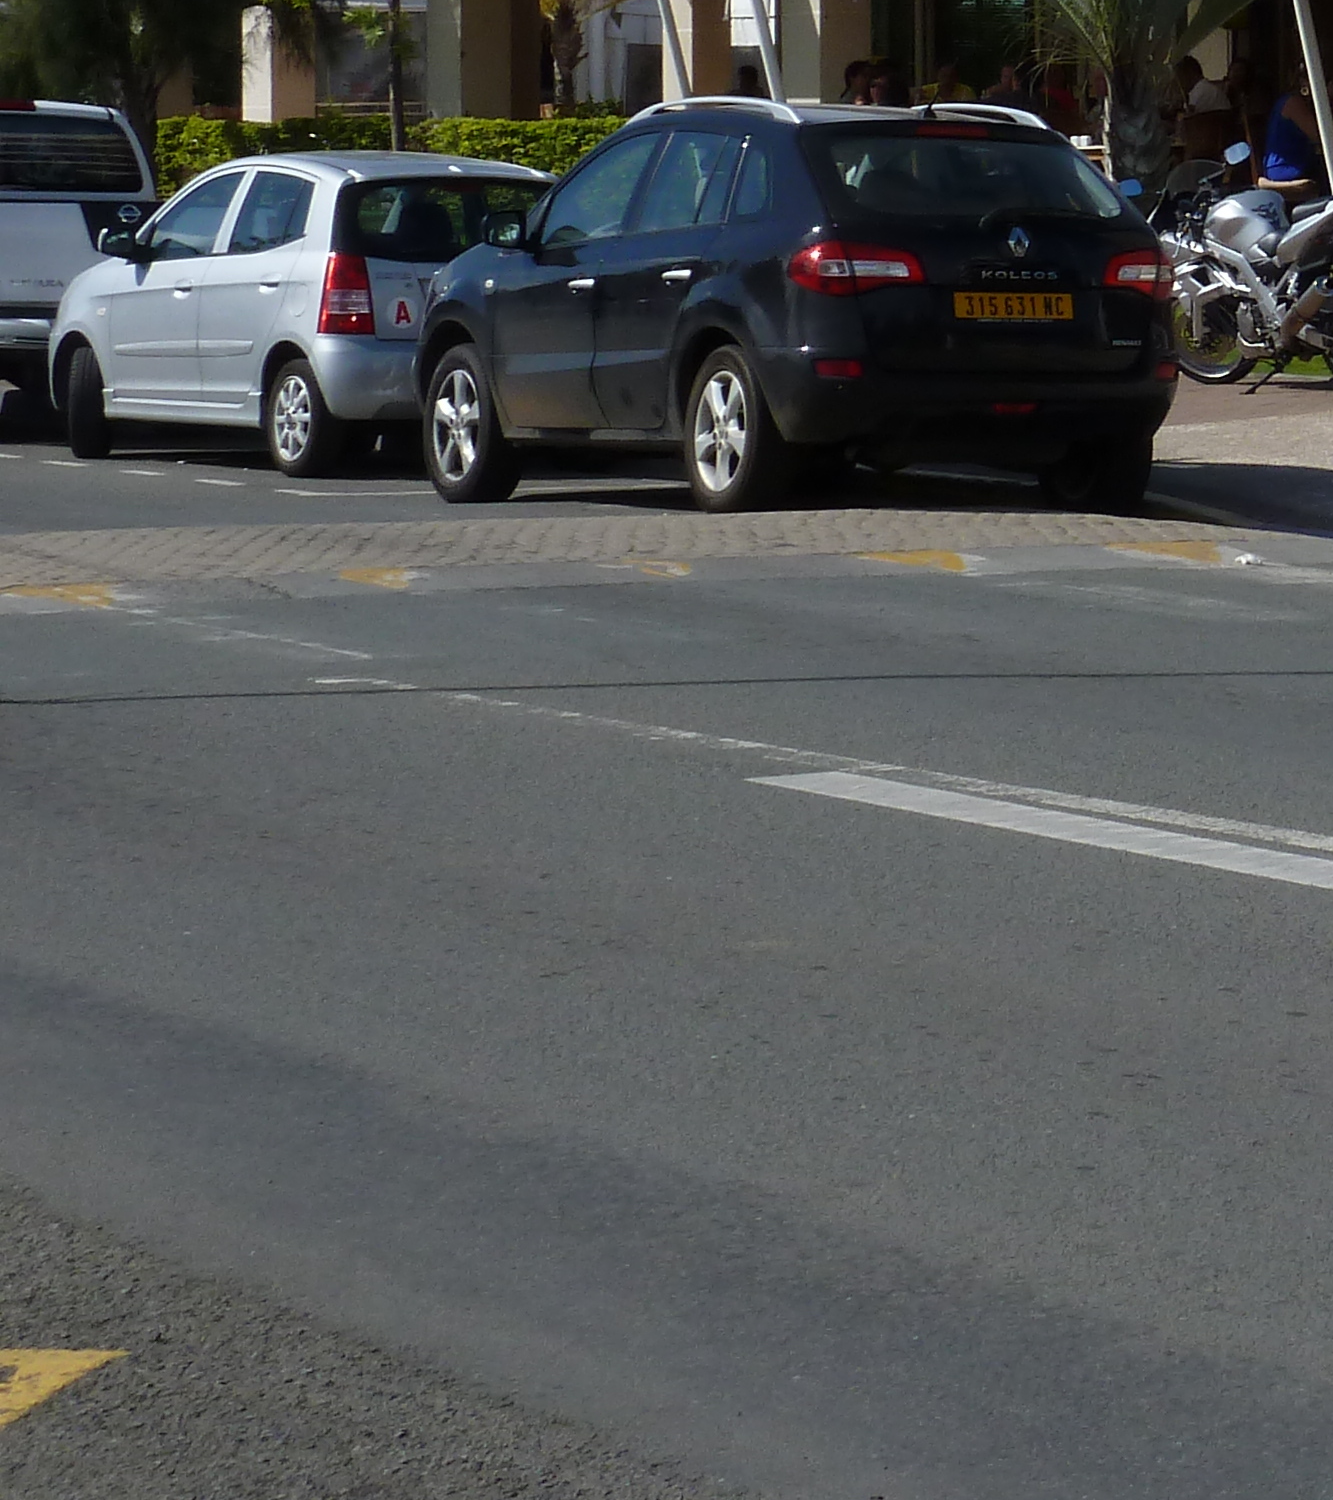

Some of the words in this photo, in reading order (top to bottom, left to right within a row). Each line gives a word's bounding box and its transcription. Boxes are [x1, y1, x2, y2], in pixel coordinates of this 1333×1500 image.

[981, 270, 1058, 279] KOLEOS
[395, 301, 411, 325] A
[965, 296, 998, 316] 315
[1005, 296, 1036, 316] 631
[1044, 296, 1064, 316] NC
